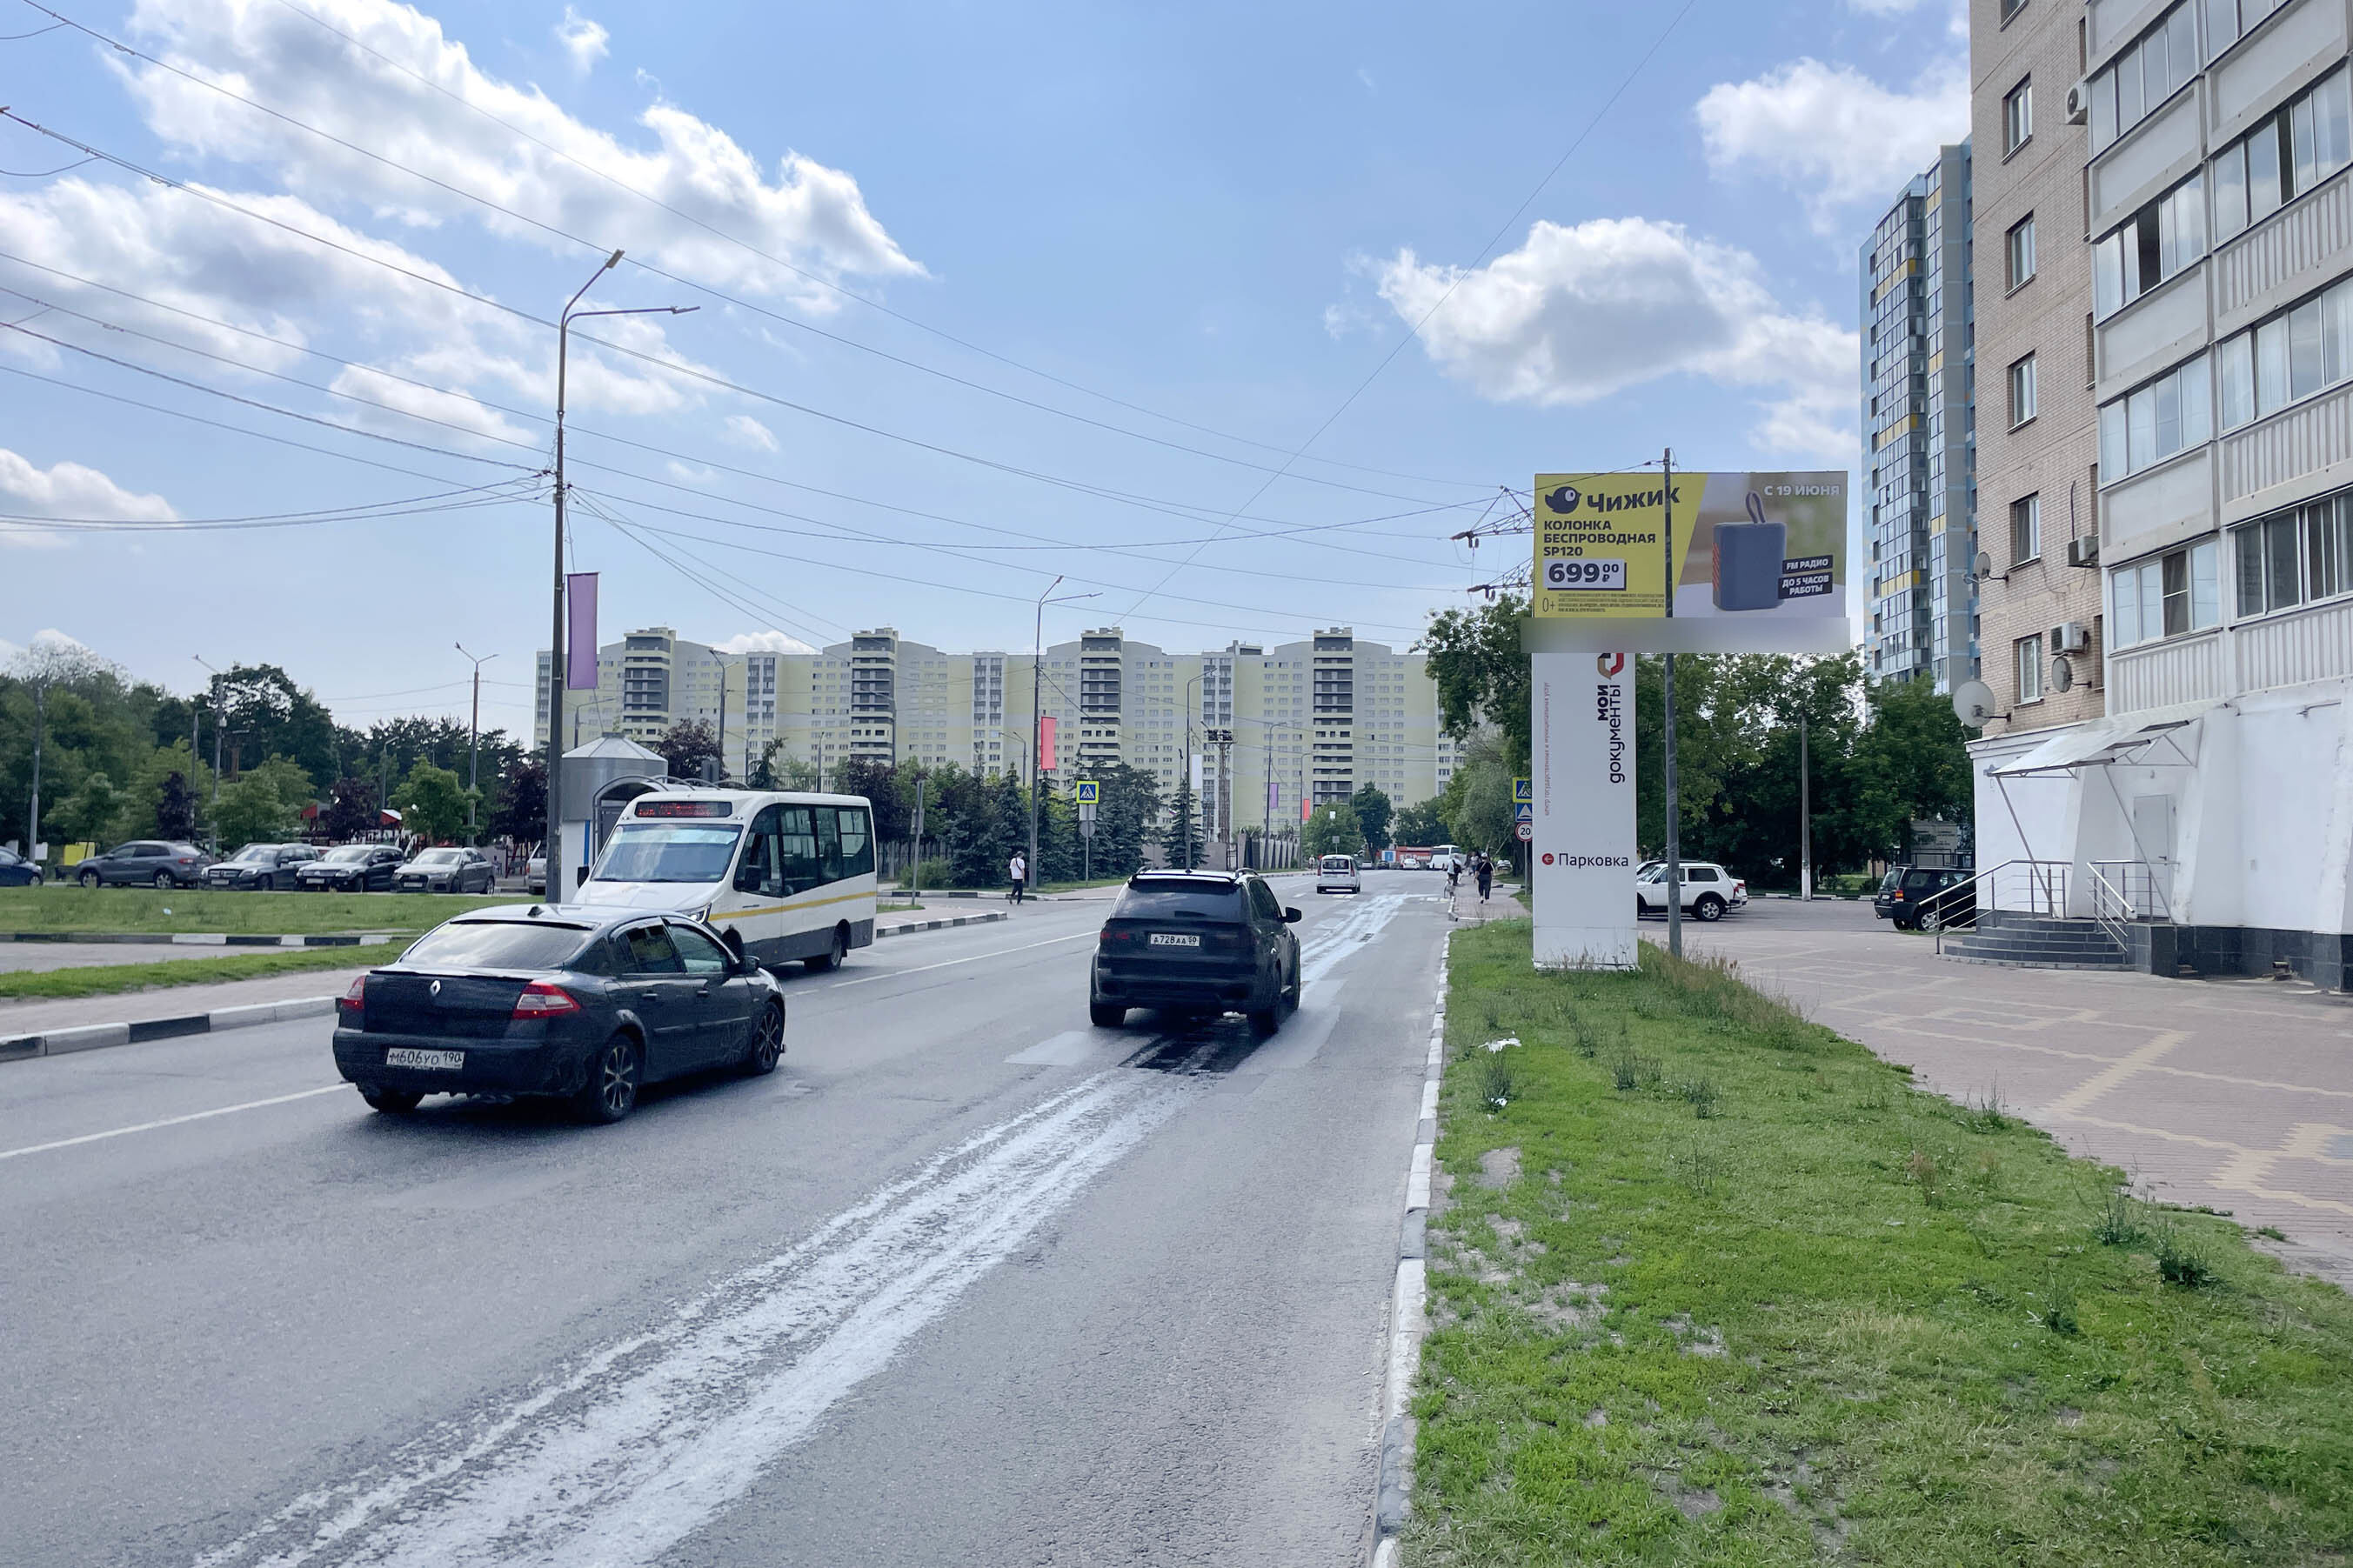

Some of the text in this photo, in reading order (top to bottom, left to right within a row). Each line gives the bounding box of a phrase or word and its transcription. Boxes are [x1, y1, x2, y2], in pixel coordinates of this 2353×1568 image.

[1764, 485, 1840, 496] С 19 ИЮНЯ
[1587, 486, 1681, 513] Чижик
[1544, 520, 1612, 530] КОЛОНКА
[1544, 533, 1656, 545] БЕСПРОВОДНАЯ
[1543, 546, 1583, 557] SP120
[1786, 558, 1828, 570] FM РАДИО
[1548, 563, 1600, 583] 699
[1781, 578, 1795, 589] ДО
[1802, 575, 1829, 584] ЧАСОВ
[1789, 584, 1823, 595] РАБОТЫ
[1542, 597, 1555, 612] 0+
[1609, 684, 1625, 784] документы
[1520, 827, 1531, 836] 20
[1558, 852, 1628, 869] Парковка
